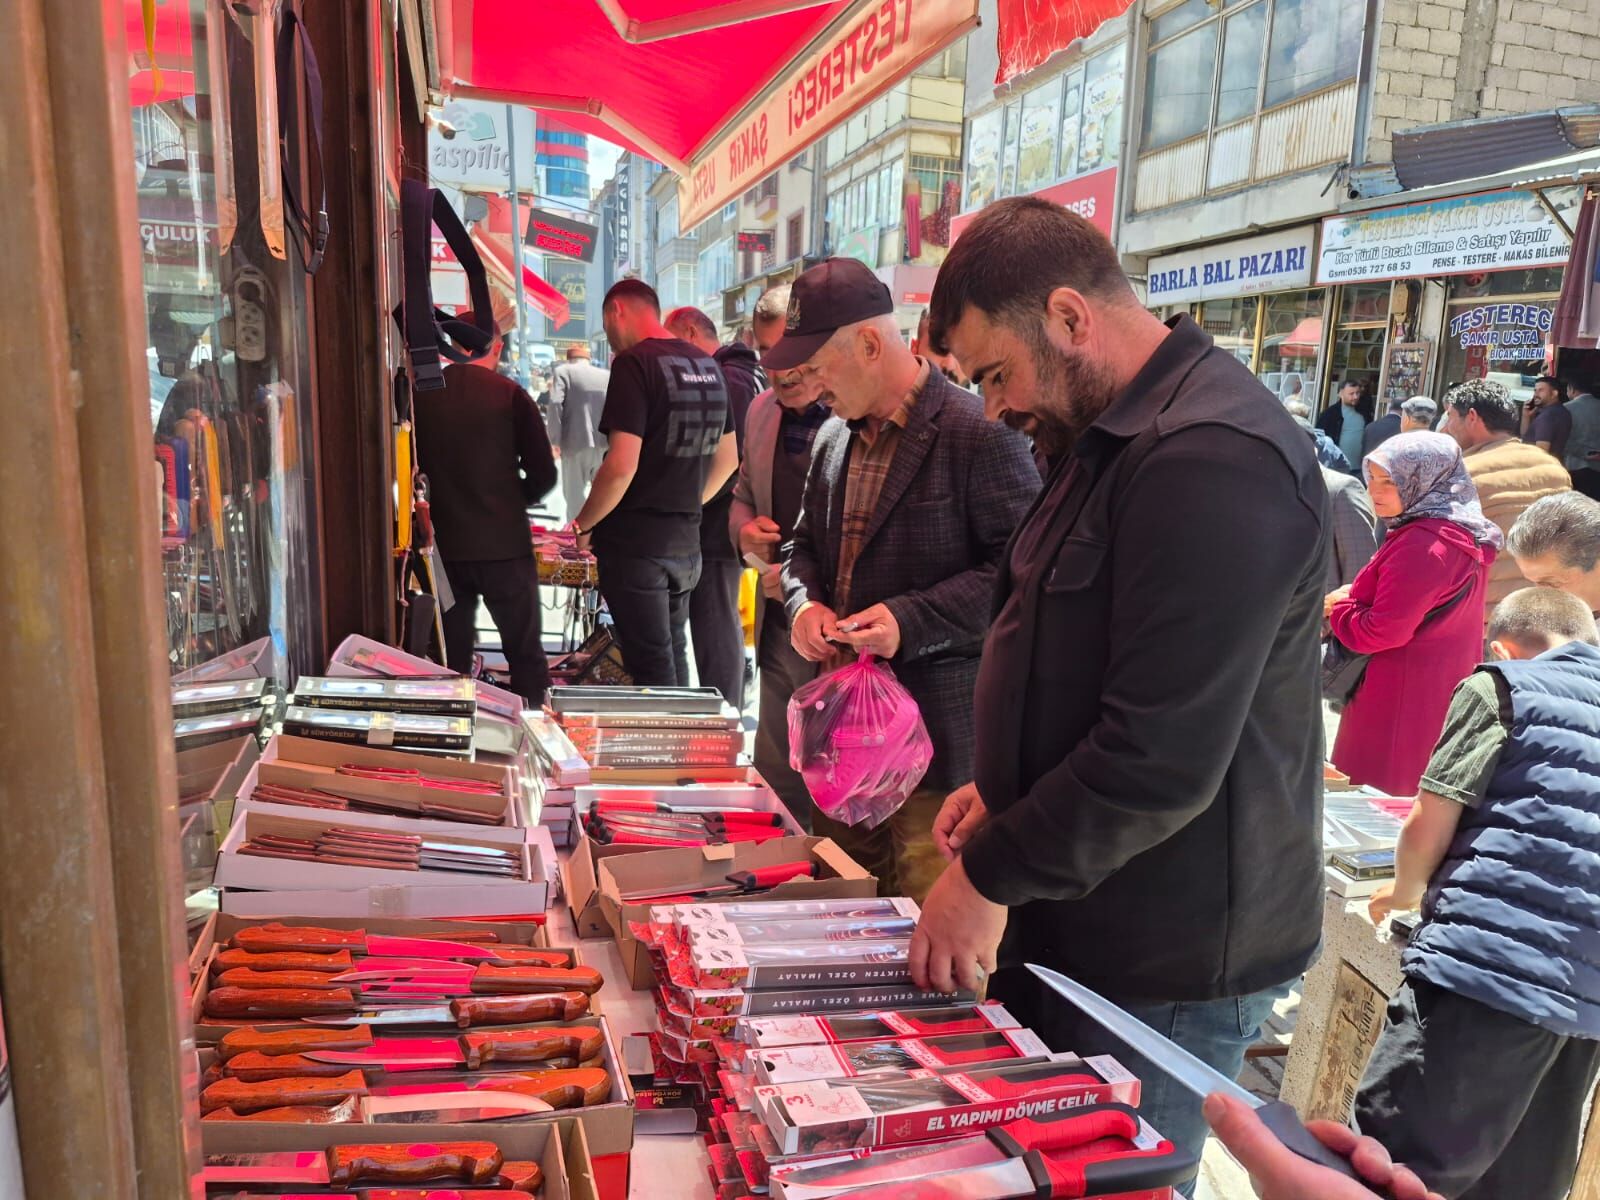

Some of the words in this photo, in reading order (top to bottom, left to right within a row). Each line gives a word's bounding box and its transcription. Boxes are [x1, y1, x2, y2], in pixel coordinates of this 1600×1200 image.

[1335, 250, 1353, 265] Her
[1355, 246, 1380, 262] Türlü
[1414, 239, 1454, 257] Bileme
[1456, 237, 1468, 251] &
[1469, 234, 1507, 250] Satışı
[1510, 227, 1552, 248] Yapılır
[1432, 256, 1457, 268] PENSE
[1463, 252, 1498, 266] TESTERE
[1503, 248, 1534, 262] MAKAS
[1149, 266, 1198, 294] BARLA
[1203, 259, 1235, 286] BAL
[1238, 245, 1307, 280] PAZARI
[1370, 264, 1385, 274] 727
[1400, 261, 1411, 271] 53
[1450, 303, 1554, 338] TESTEREC
[1502, 329, 1539, 345] USTA
[865, 970, 912, 979] ELİKTEN
[927, 1116, 945, 1132] EL
[949, 1106, 1003, 1129] YAPIMI
[1004, 1099, 1057, 1121] DÖVME
